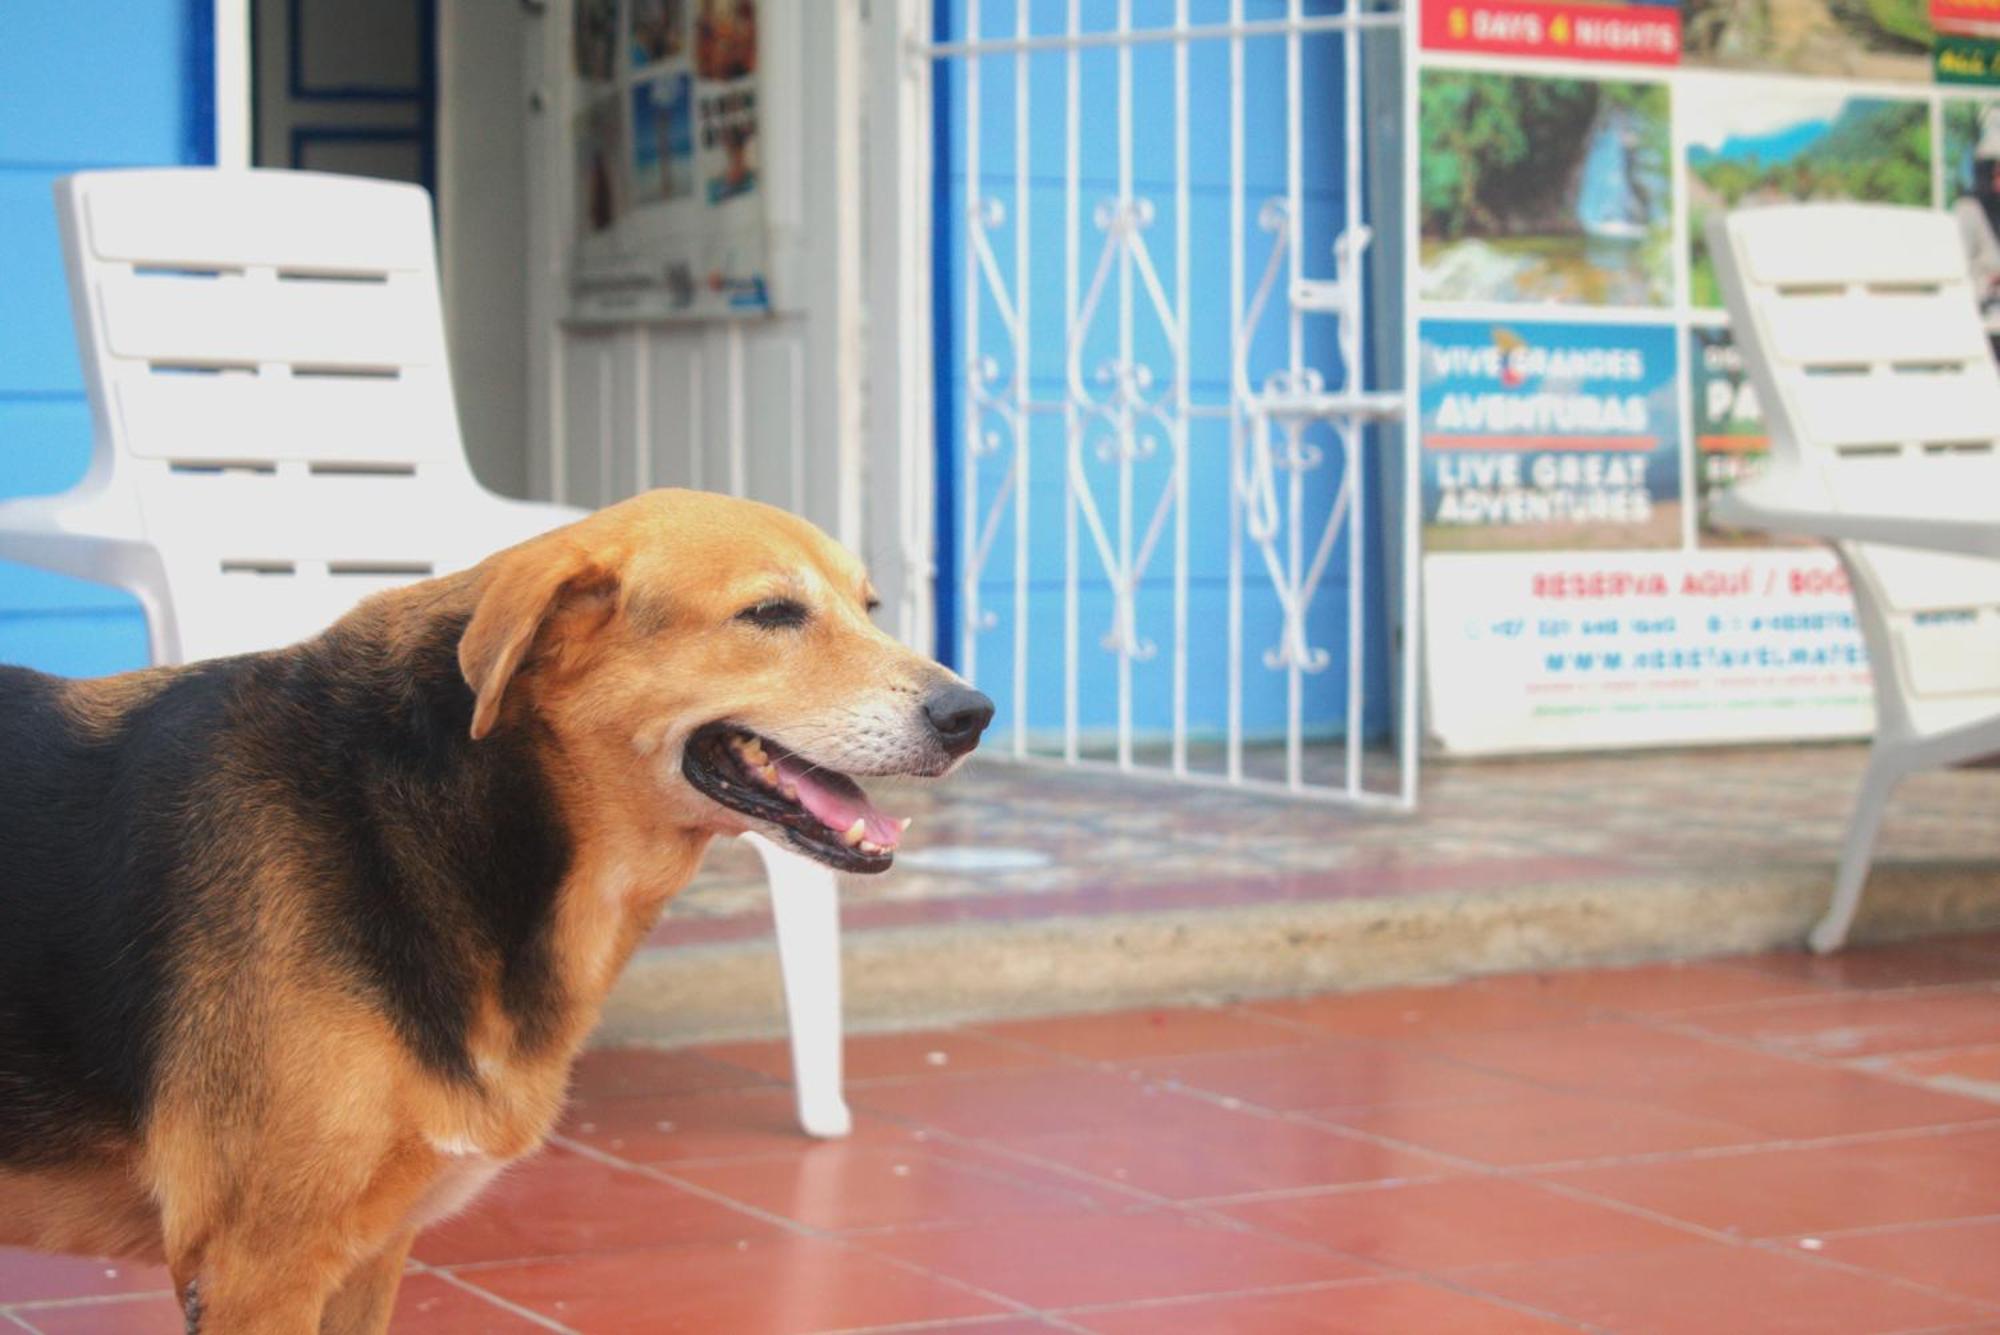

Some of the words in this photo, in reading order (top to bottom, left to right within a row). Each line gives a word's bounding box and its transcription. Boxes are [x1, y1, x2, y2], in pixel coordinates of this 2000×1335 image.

[1472, 10, 1542, 43] DAYS
[1549, 13, 1570, 46] 4
[1574, 17, 1677, 53] NIGHTS
[1432, 346, 1500, 378] VIVE
[1505, 346, 1643, 383] GRANDES
[1435, 393, 1649, 432] AVENTURAS
[1437, 454, 1520, 488] LIVE
[1531, 454, 1648, 487] GREAT
[1436, 489, 1652, 523] ADVENTURES
[1532, 572, 1669, 598] RESERVA
[1680, 568, 1751, 596] AQUÍ
[1789, 566, 1853, 596] BOO
